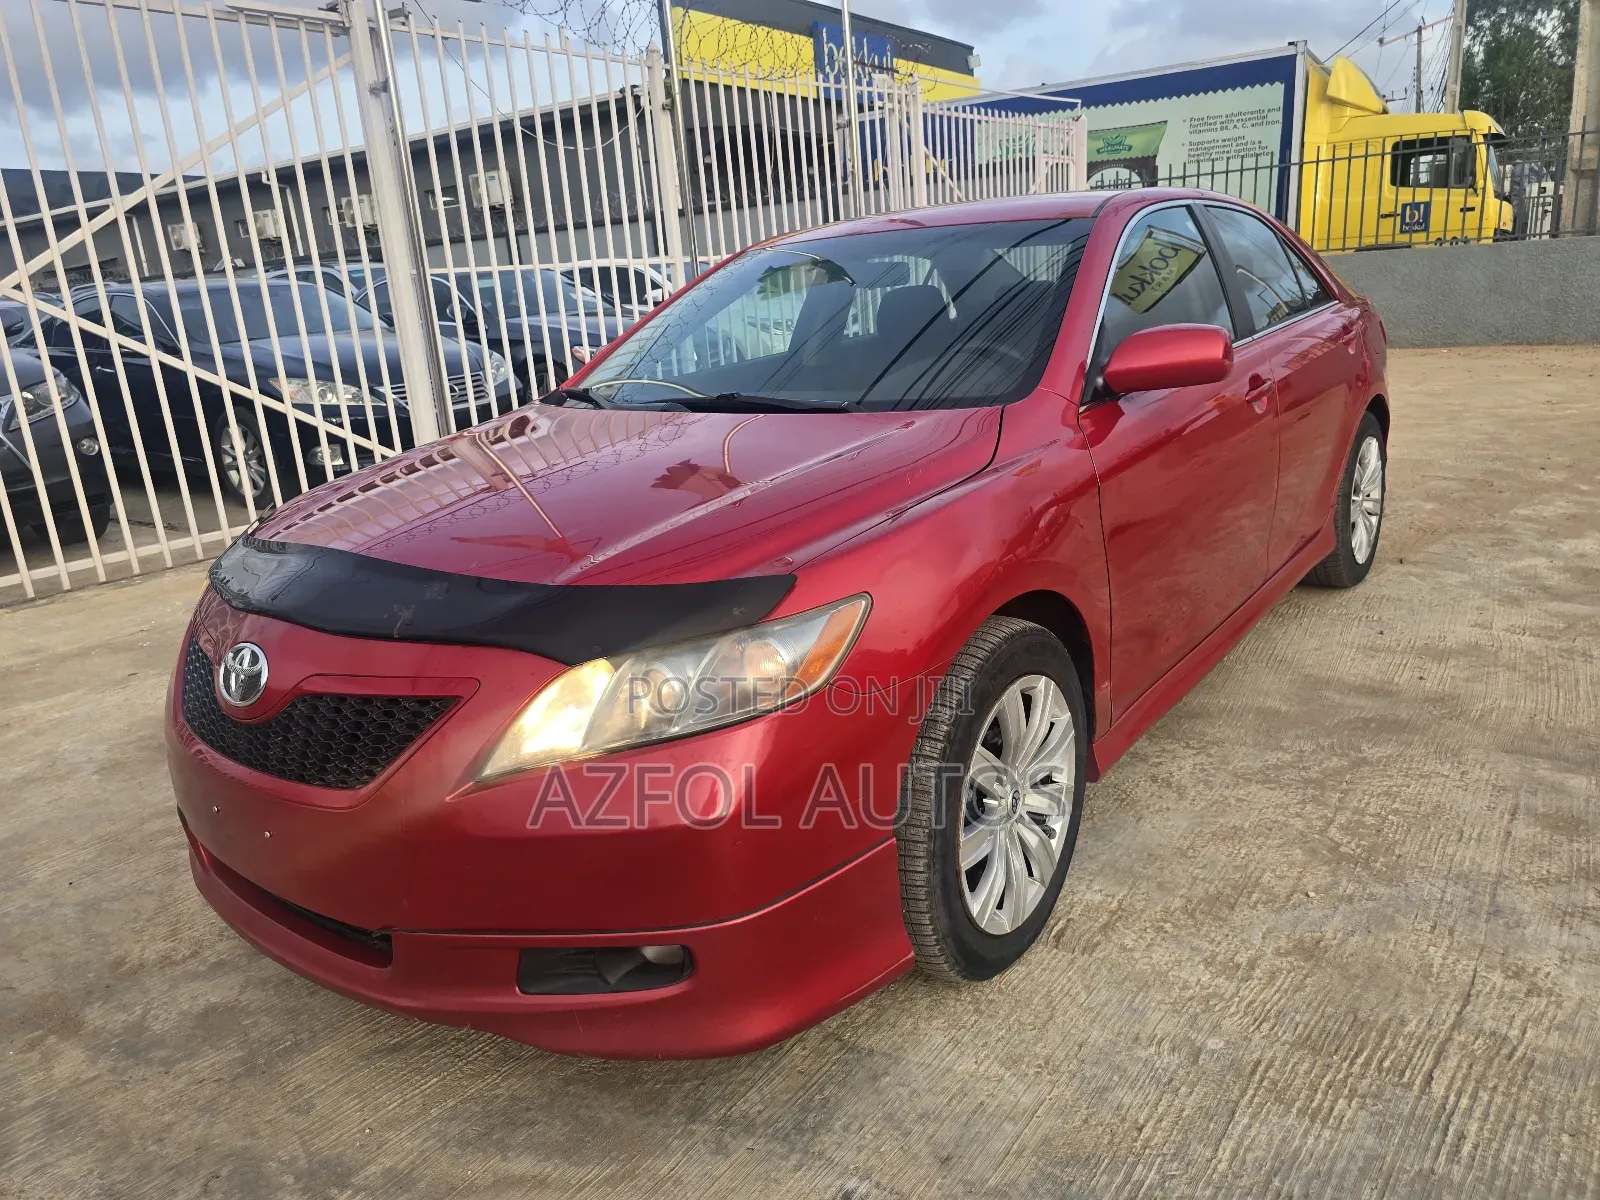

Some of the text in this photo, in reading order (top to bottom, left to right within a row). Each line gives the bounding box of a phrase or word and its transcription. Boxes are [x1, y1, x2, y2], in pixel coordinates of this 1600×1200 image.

[1206, 113, 1223, 121] from
[1224, 108, 1265, 118] adulterants
[1266, 106, 1281, 114] and
[1188, 126, 1218, 135] vitamins
[1250, 119, 1264, 127] and
[1189, 114, 1268, 129] fortified with essential
[1188, 135, 1246, 148] Supports weight
[1188, 142, 1234, 153] management
[1235, 139, 1249, 147] and
[1188, 150, 1213, 160] healthy
[1233, 146, 1257, 155] option
